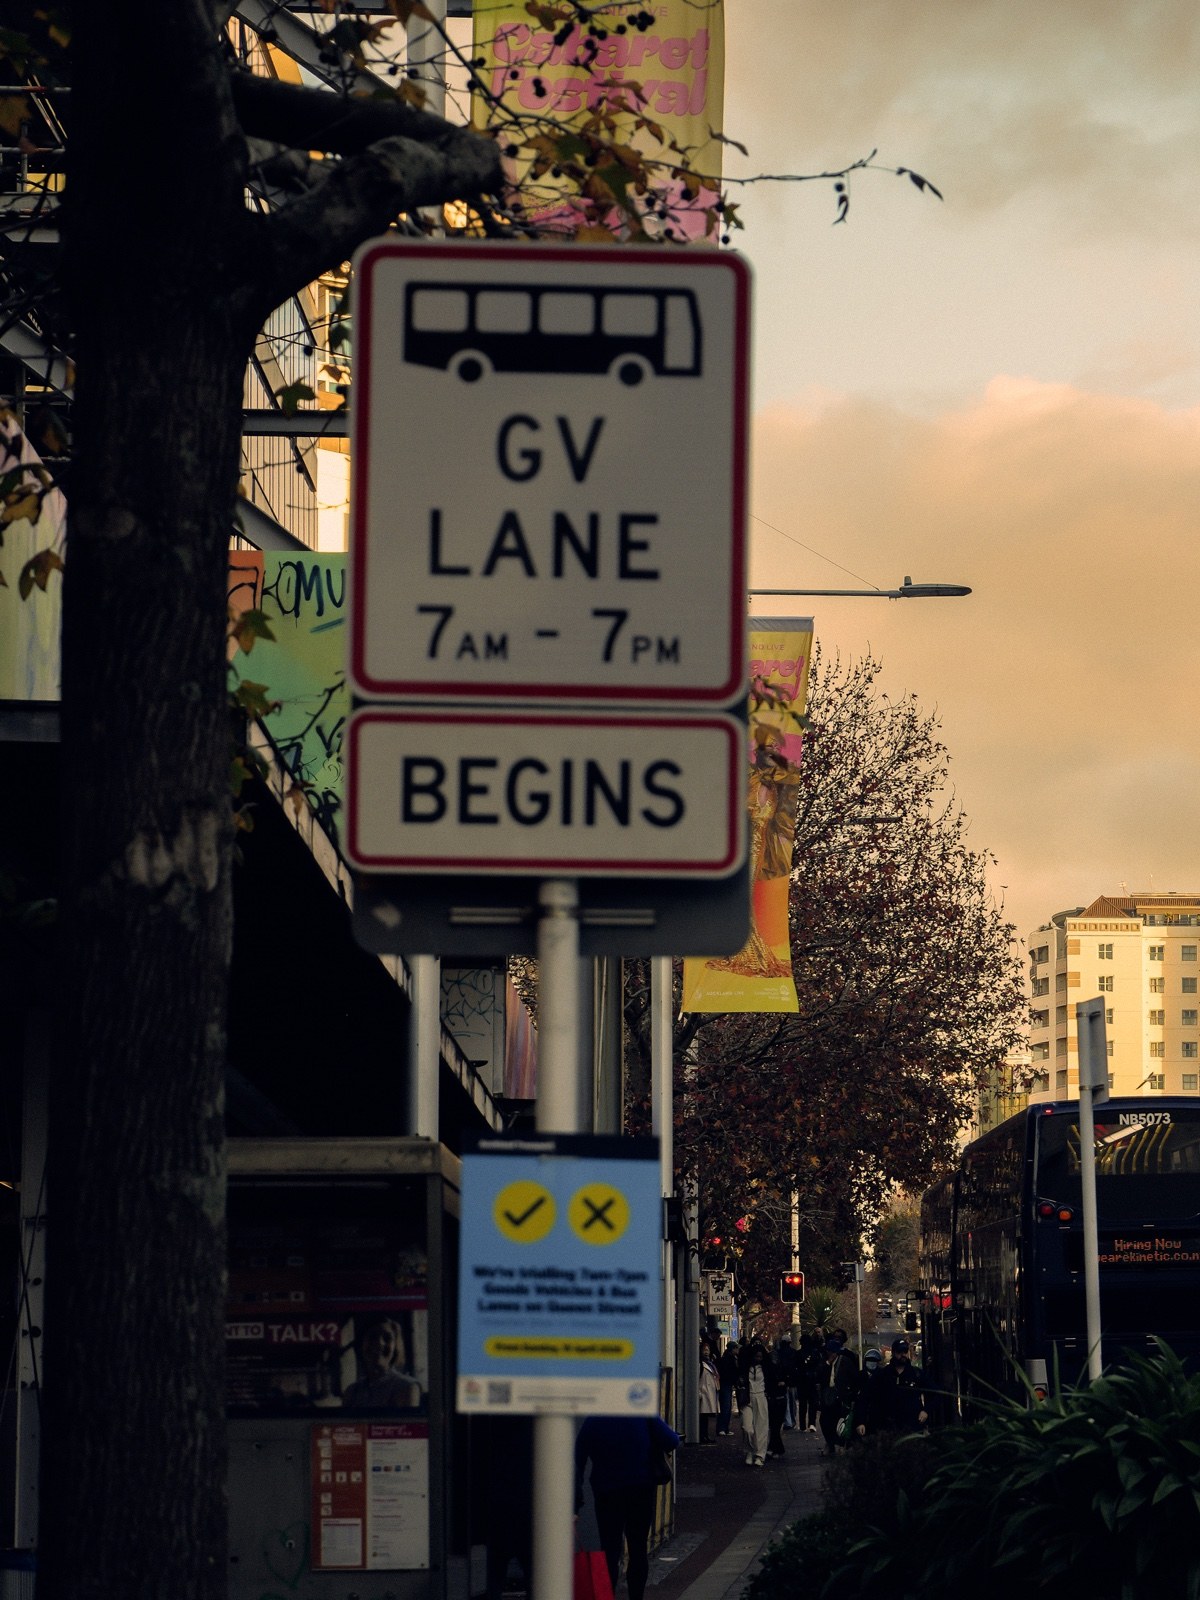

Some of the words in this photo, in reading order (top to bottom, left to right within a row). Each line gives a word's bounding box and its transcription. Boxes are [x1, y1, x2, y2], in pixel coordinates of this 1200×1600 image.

[492, 23, 711, 70] Cabaret
[495, 413, 605, 483] GV
[427, 508, 661, 580] LANE
[401, 754, 686, 829] BEGINS
[1119, 1112, 1171, 1126] NB5073
[1114, 1239, 1152, 1251] Hiring
[1155, 1238, 1182, 1250] Now
[268, 1323, 339, 1343] TALK?
